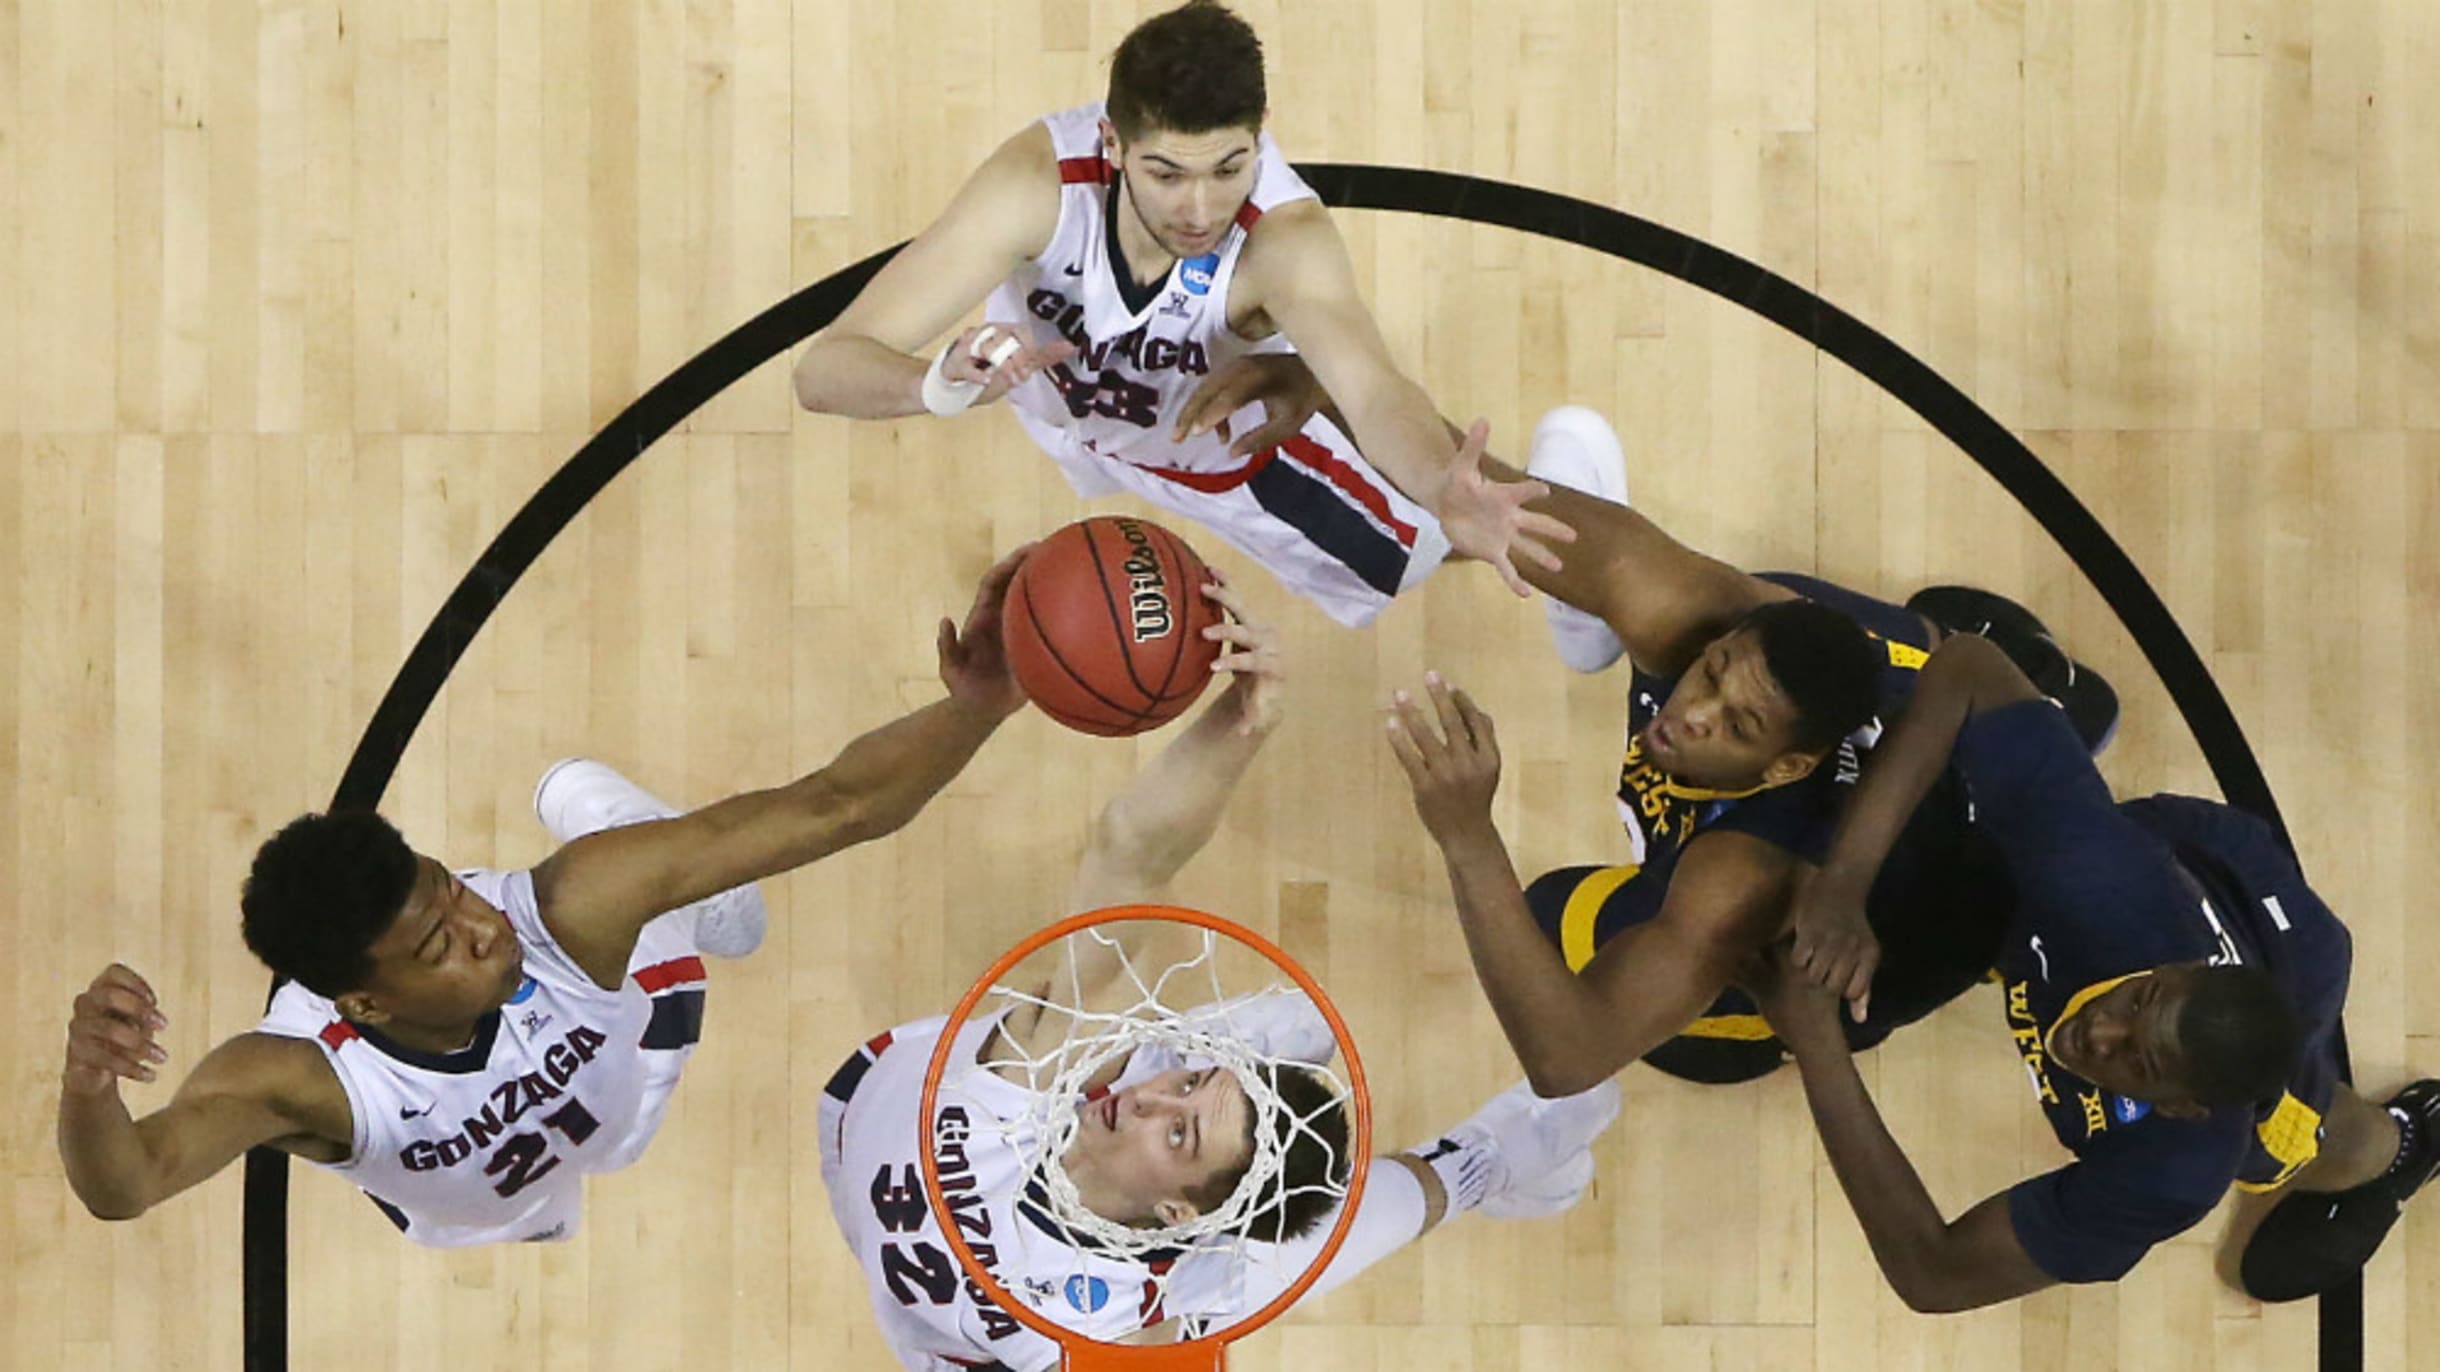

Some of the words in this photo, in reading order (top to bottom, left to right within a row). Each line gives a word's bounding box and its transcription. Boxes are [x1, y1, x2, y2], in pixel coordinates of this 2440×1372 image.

[1027, 290, 1209, 377] GONAGA
[1113, 519, 1173, 643] Wilson
[399, 1025, 607, 1172] GONZAGA
[483, 1096, 602, 1199] 21
[870, 1163, 958, 1306] 32
